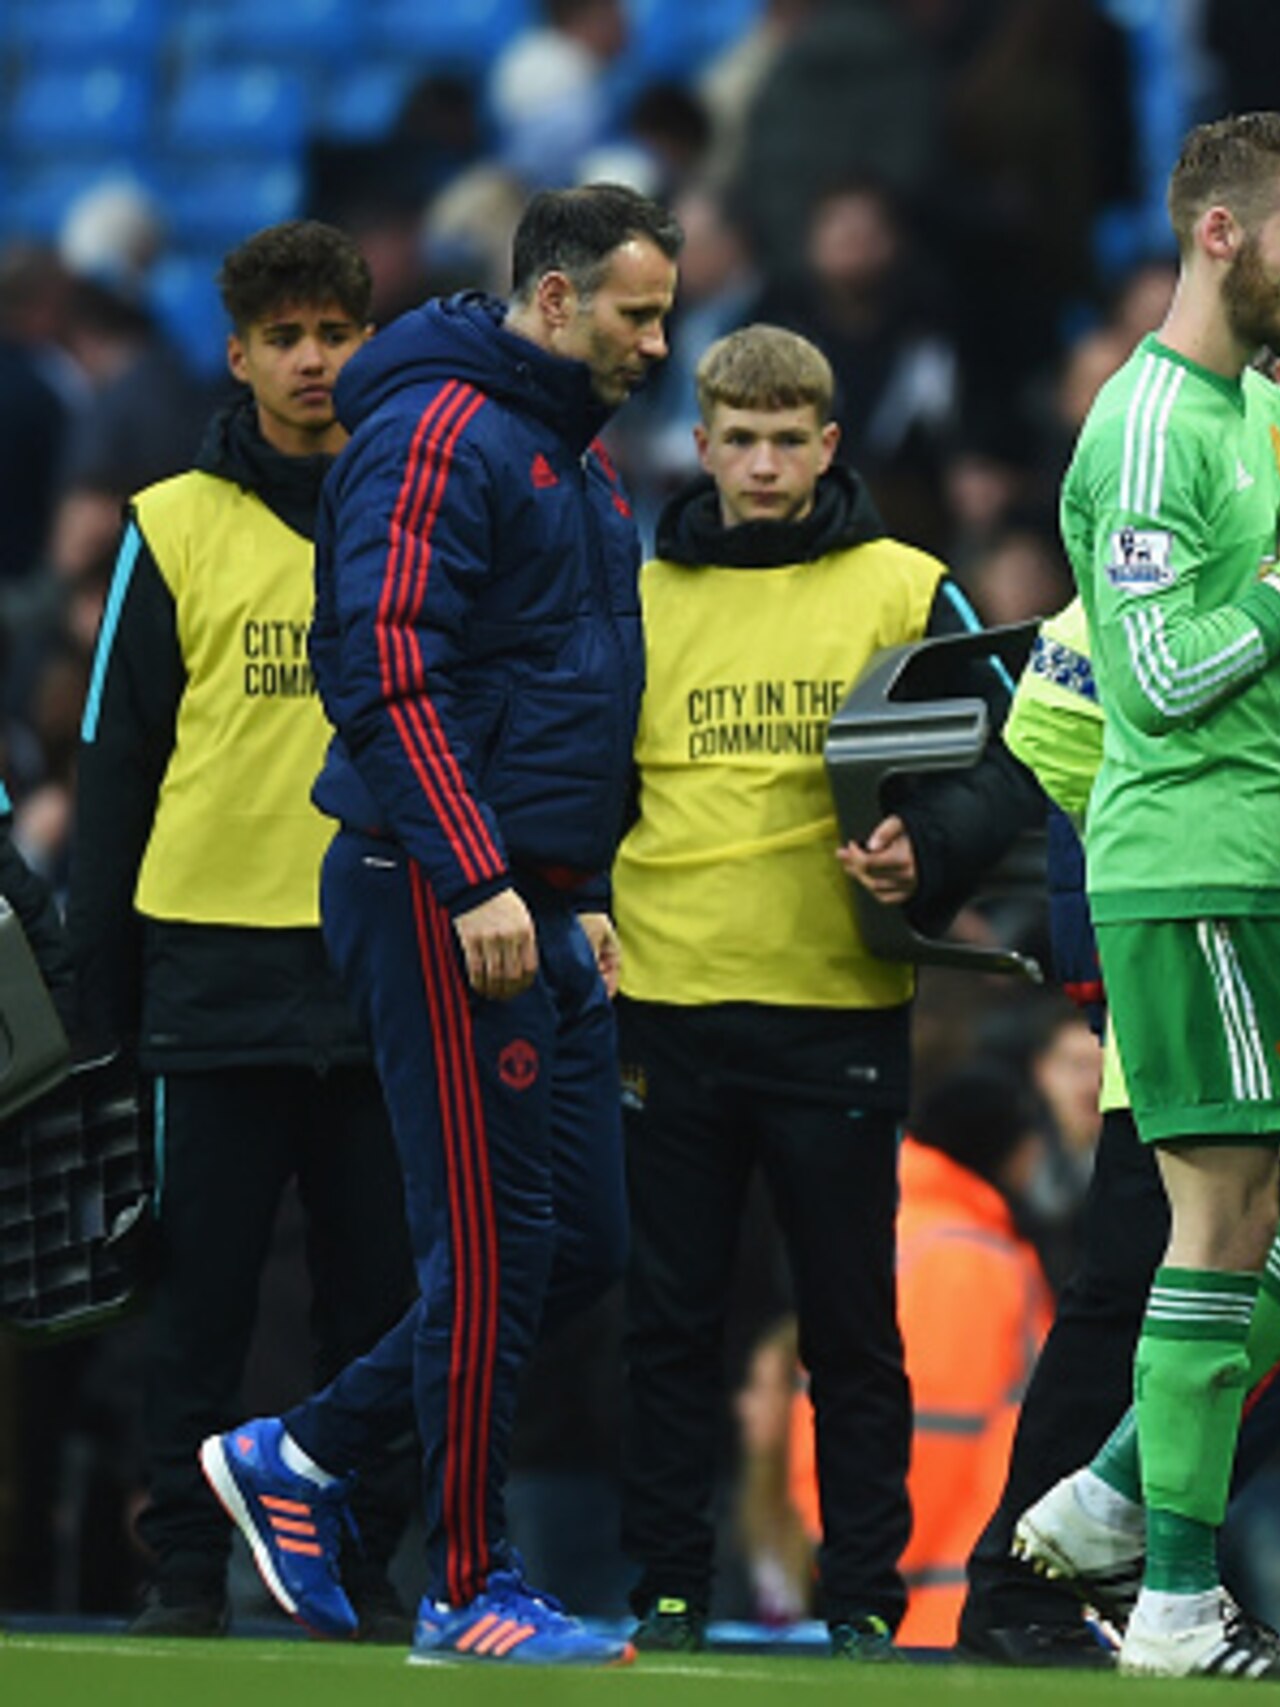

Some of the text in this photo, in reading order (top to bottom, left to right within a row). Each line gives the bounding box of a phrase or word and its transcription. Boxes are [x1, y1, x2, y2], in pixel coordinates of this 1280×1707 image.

[244, 620, 307, 658] CITY
[688, 684, 747, 725] CITY
[754, 680, 785, 717] IN
